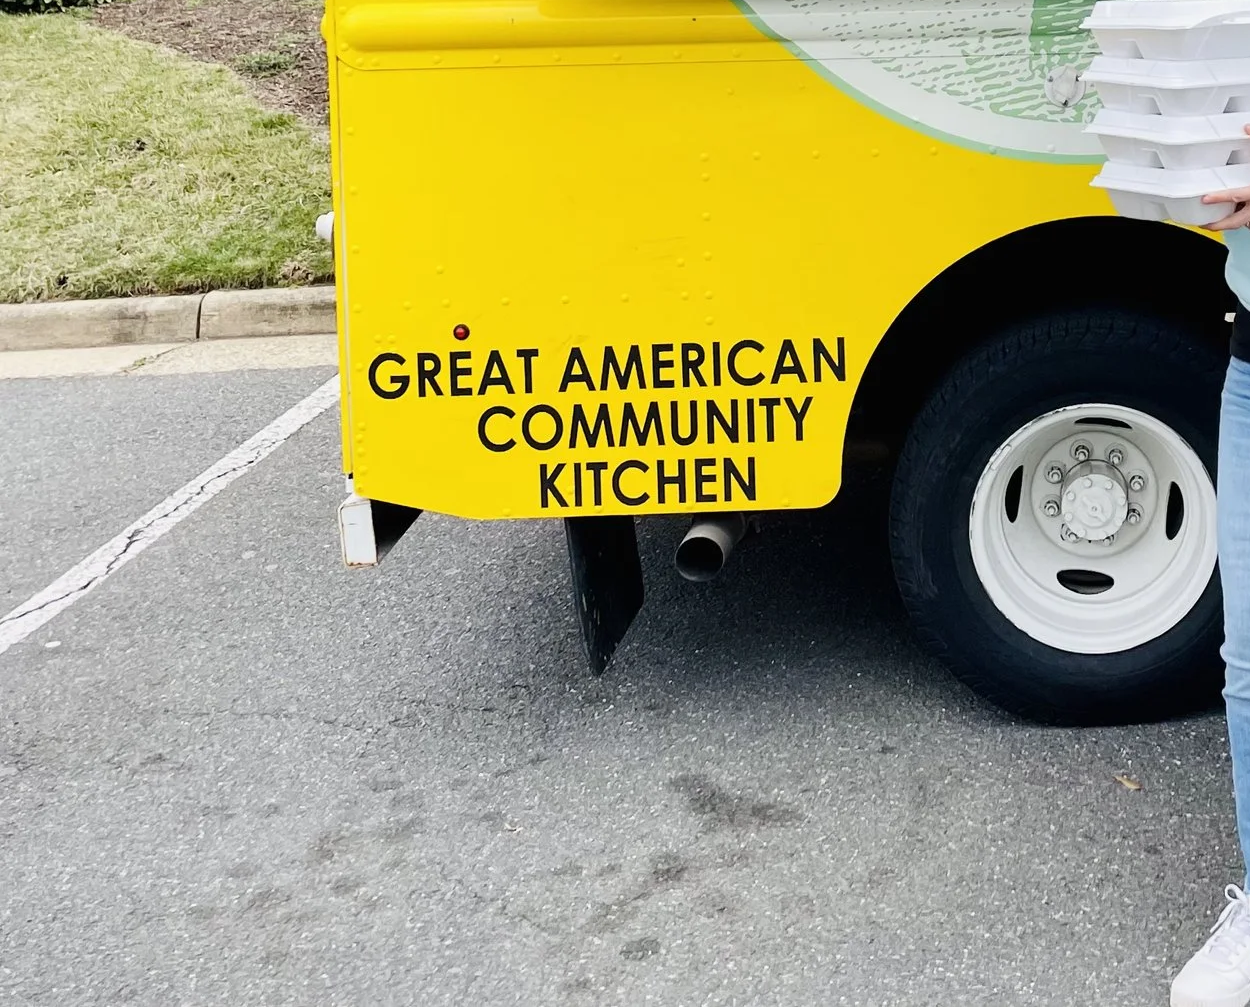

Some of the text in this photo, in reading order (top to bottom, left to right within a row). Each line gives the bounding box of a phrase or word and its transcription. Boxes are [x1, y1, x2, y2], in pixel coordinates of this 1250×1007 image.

[368, 337, 847, 400] GREAT AMERICAN
[477, 396, 815, 453] COMMUNITY
[538, 456, 757, 509] KITCHEN
